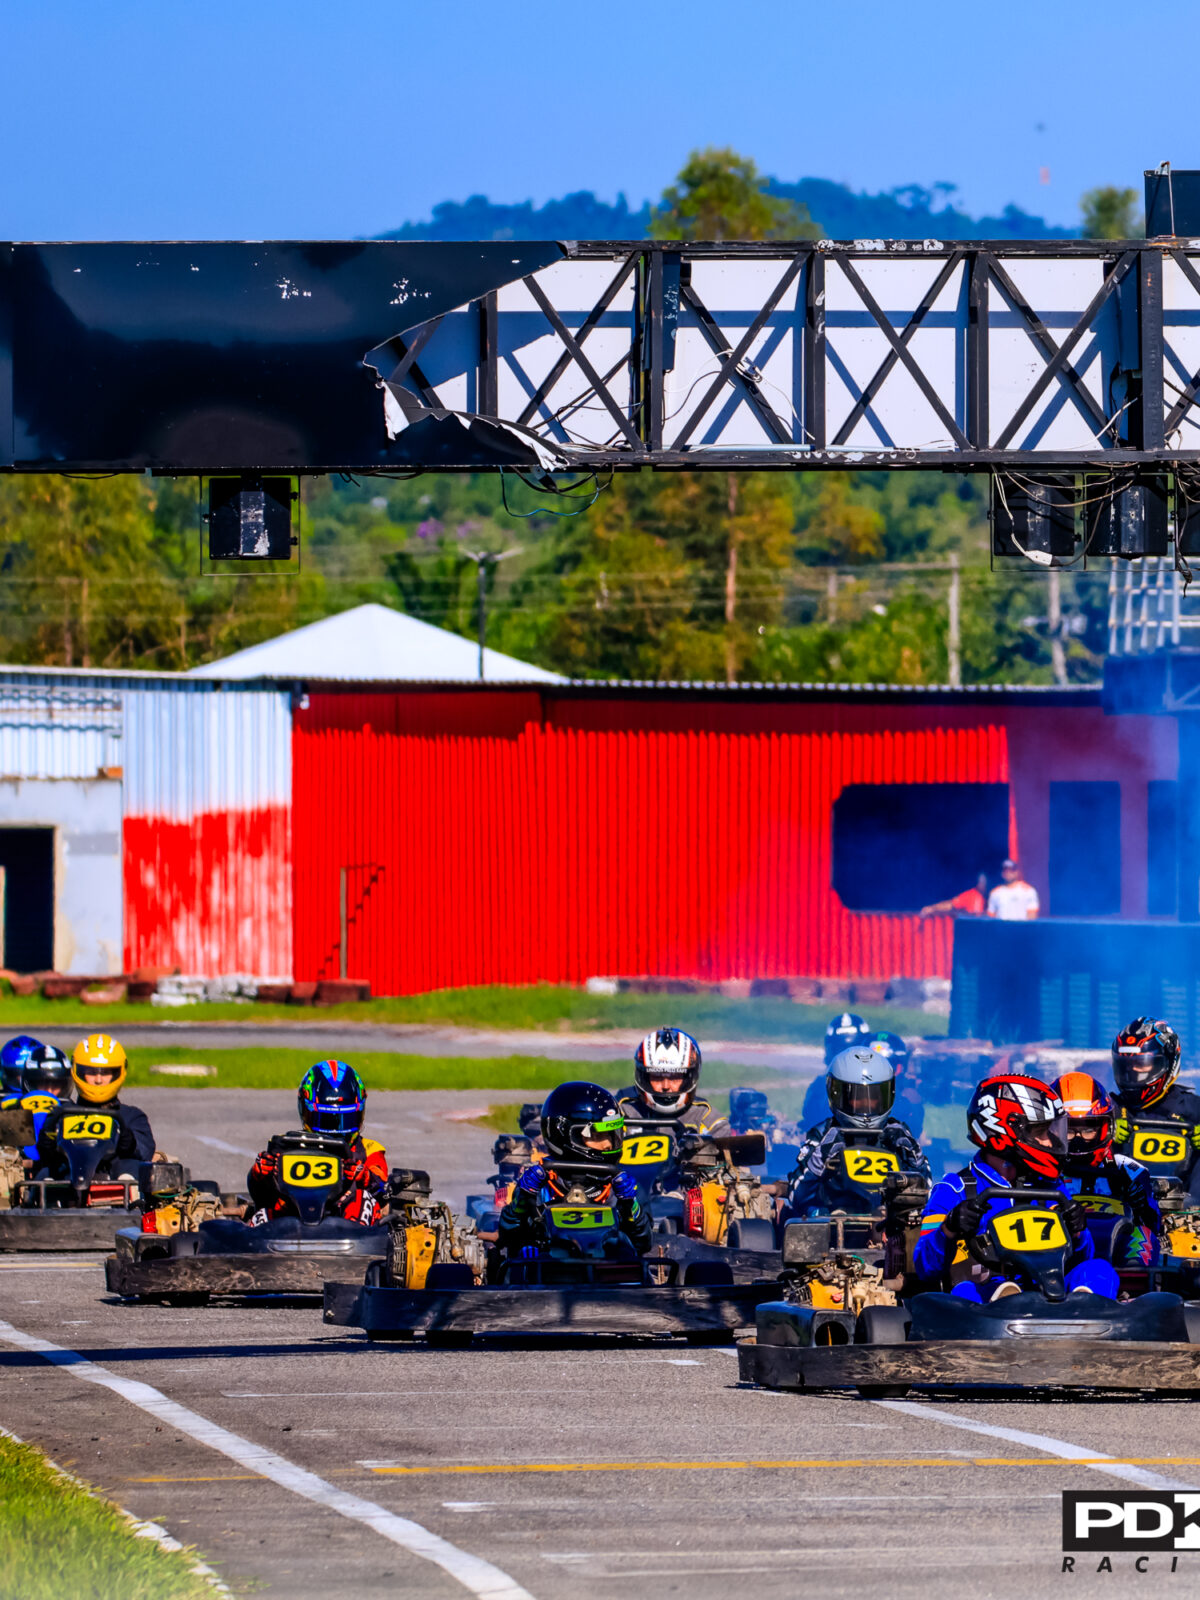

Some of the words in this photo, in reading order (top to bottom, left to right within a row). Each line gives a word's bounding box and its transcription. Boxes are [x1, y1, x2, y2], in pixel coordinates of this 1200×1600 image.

[68, 1121, 106, 1135] 40
[627, 1141, 664, 1159] 12
[1140, 1138, 1180, 1156] 08
[289, 1161, 333, 1180] 03
[853, 1156, 893, 1176] 23
[1082, 1200, 1111, 1213] 27
[561, 1211, 603, 1224] 31
[1009, 1217, 1055, 1243] 17
